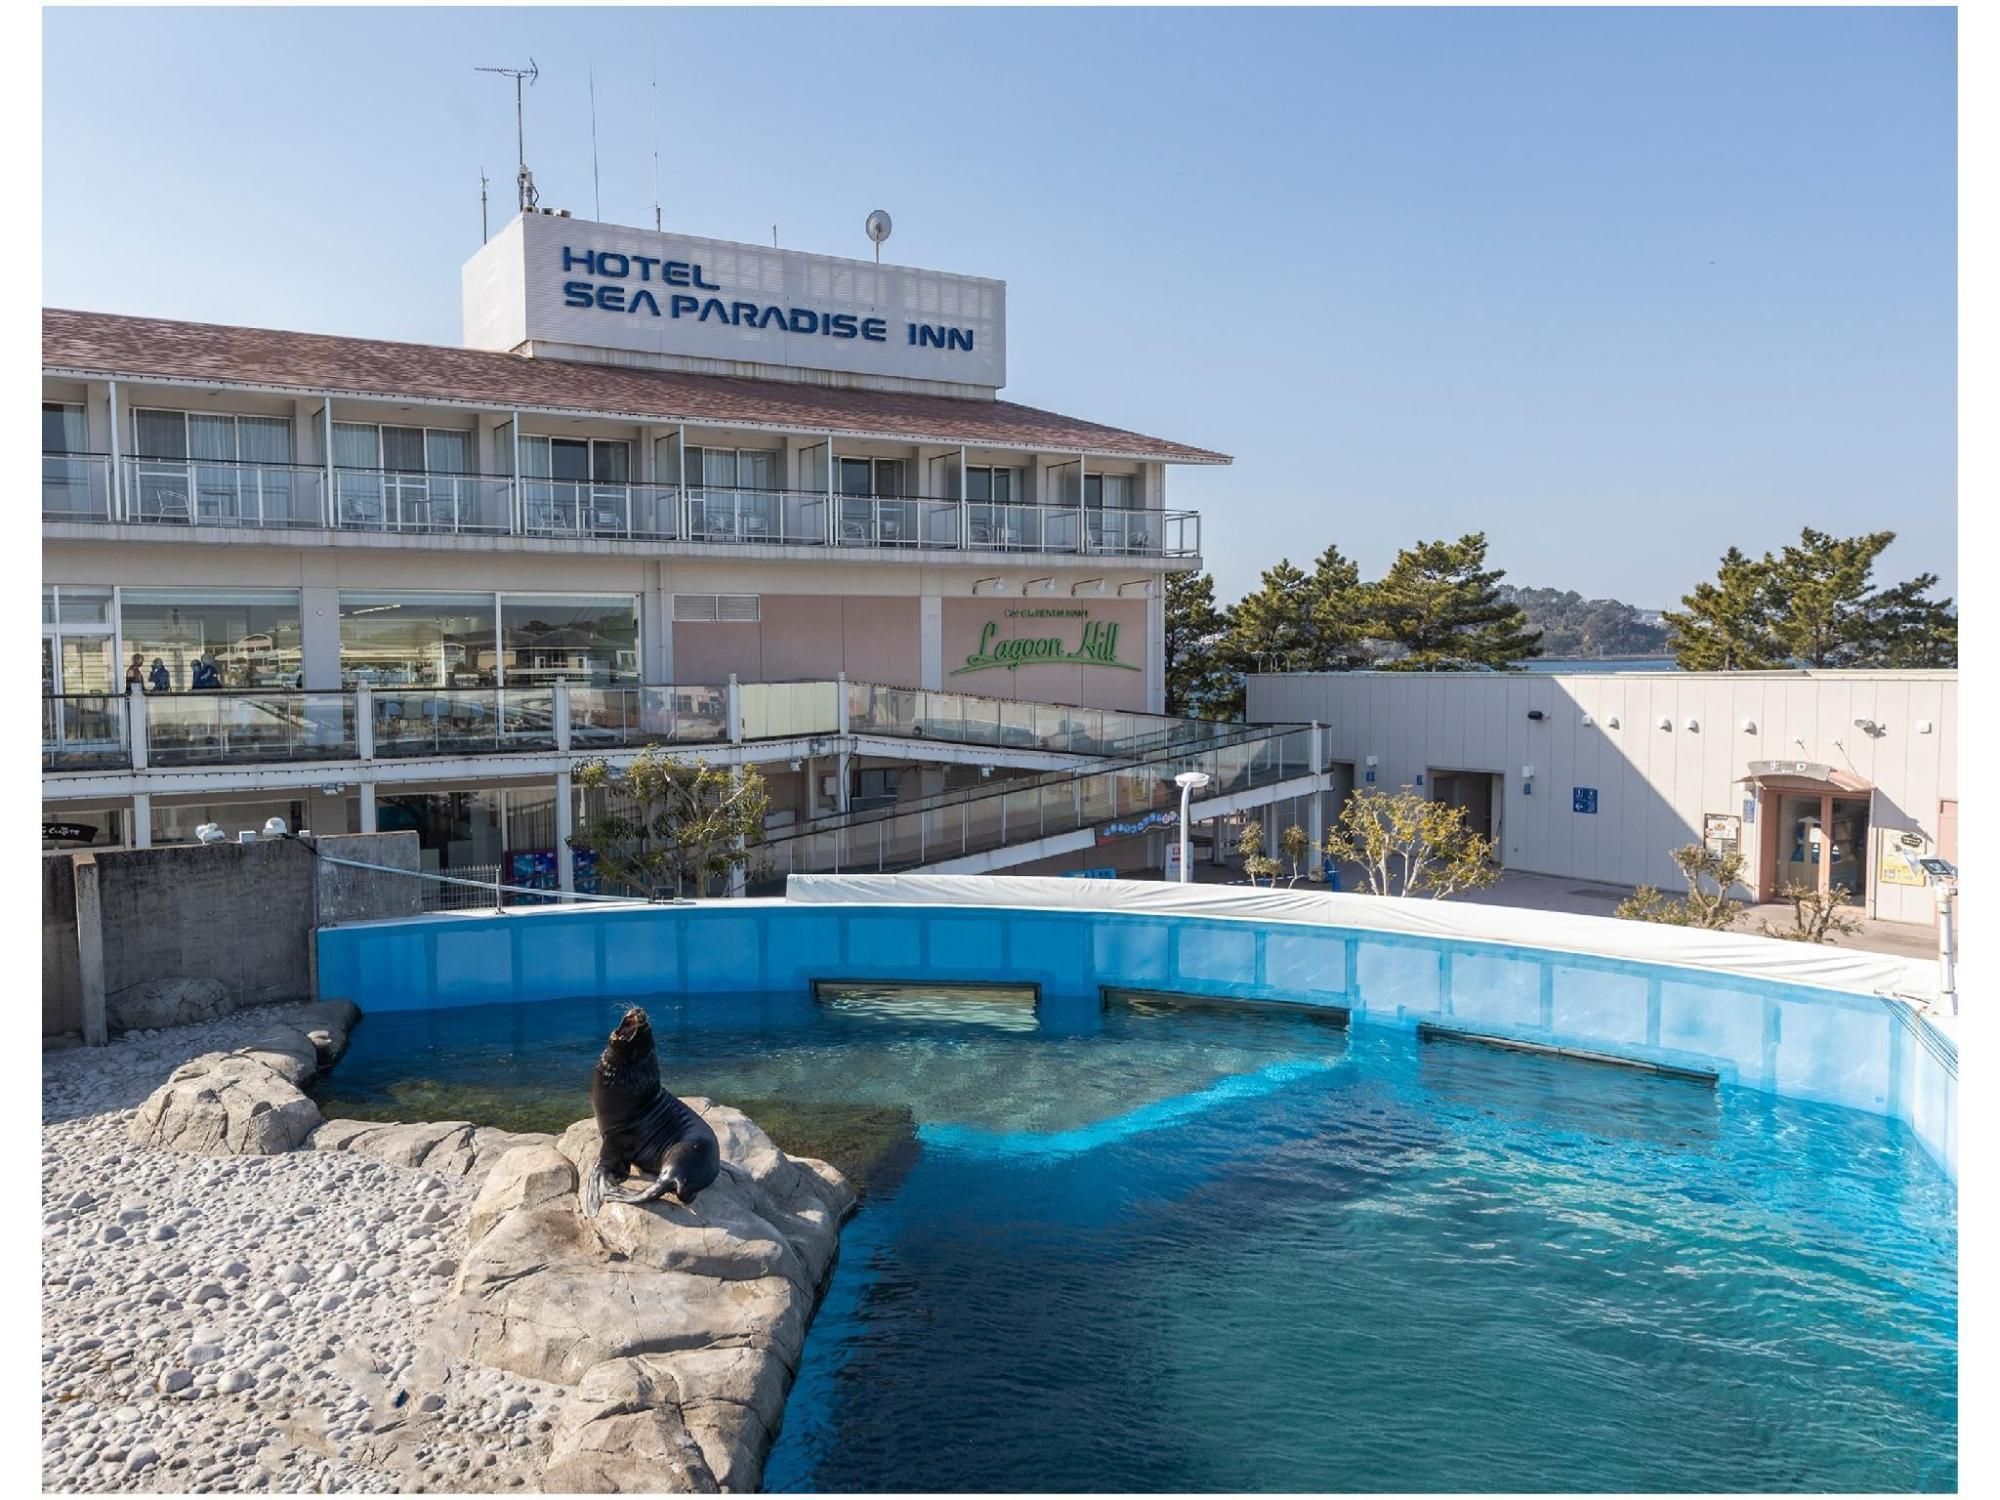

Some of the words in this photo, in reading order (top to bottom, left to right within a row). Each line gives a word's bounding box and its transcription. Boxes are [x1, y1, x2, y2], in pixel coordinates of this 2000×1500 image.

[562, 246, 720, 291] HOTEL
[562, 280, 661, 317] SEA
[671, 294, 887, 342] PARADISE
[908, 322, 974, 352] INN
[967, 621, 1063, 671] Lagoon
[1068, 620, 1120, 662] Hill
